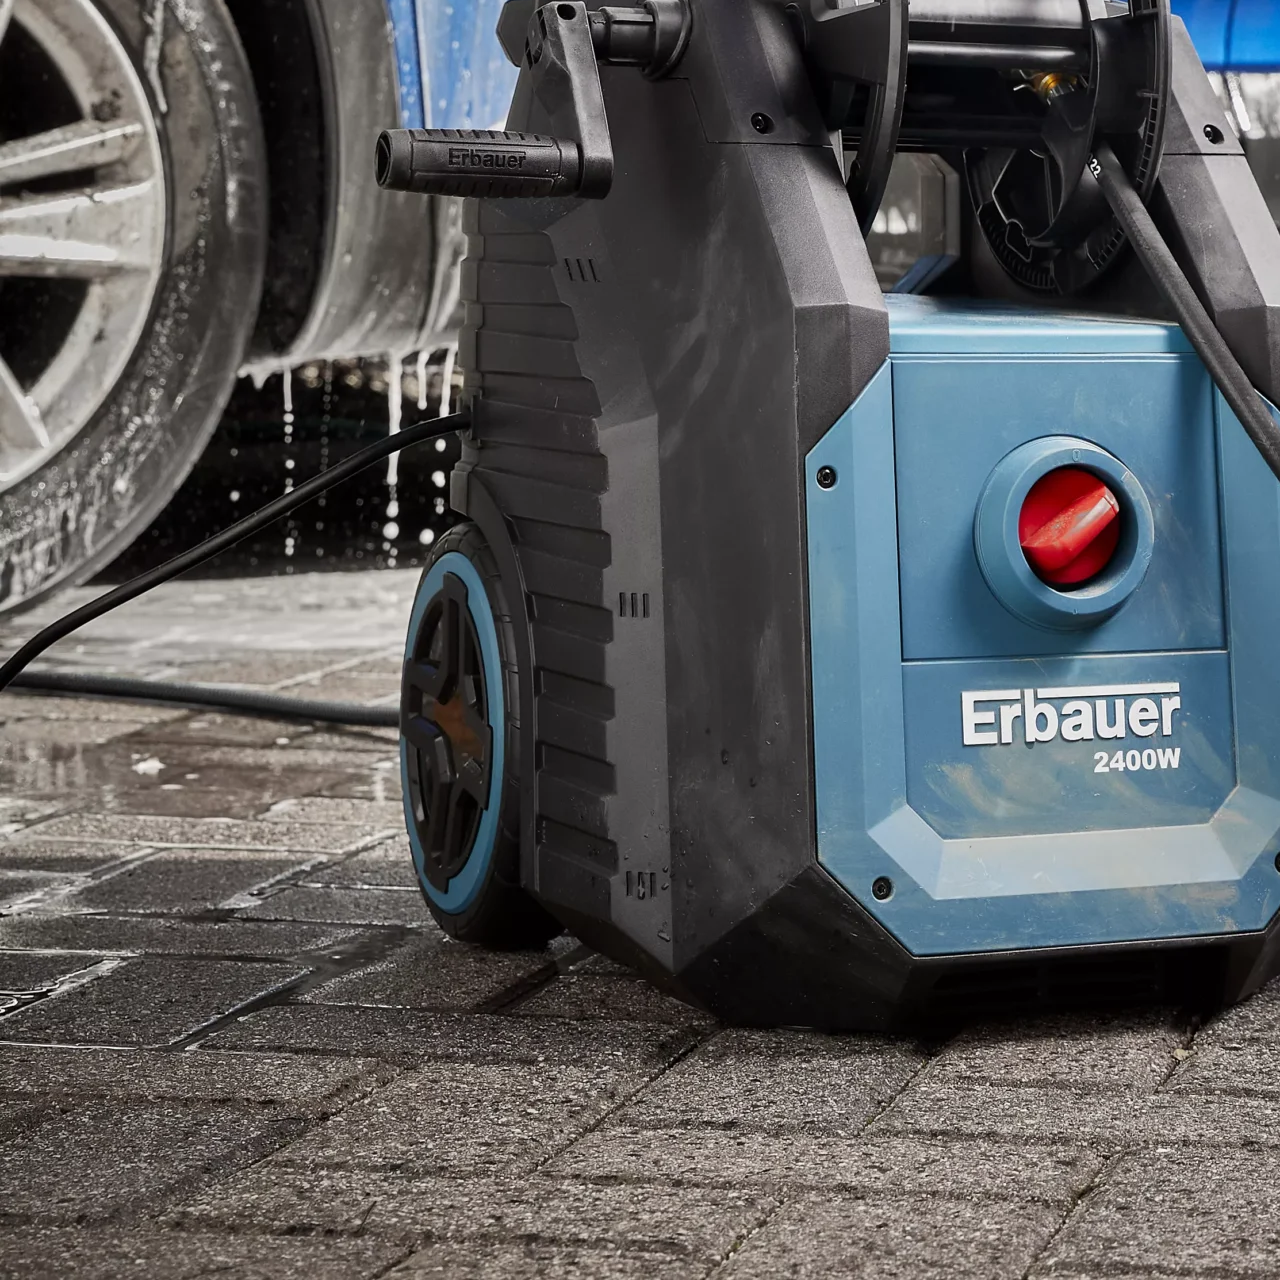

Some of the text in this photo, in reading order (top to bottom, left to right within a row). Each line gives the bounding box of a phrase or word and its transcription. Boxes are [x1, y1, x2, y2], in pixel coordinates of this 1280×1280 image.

[448, 147, 527, 169] Erbauer
[961, 682, 1181, 746] Erbauer
[1093, 747, 1181, 773] 2400W
